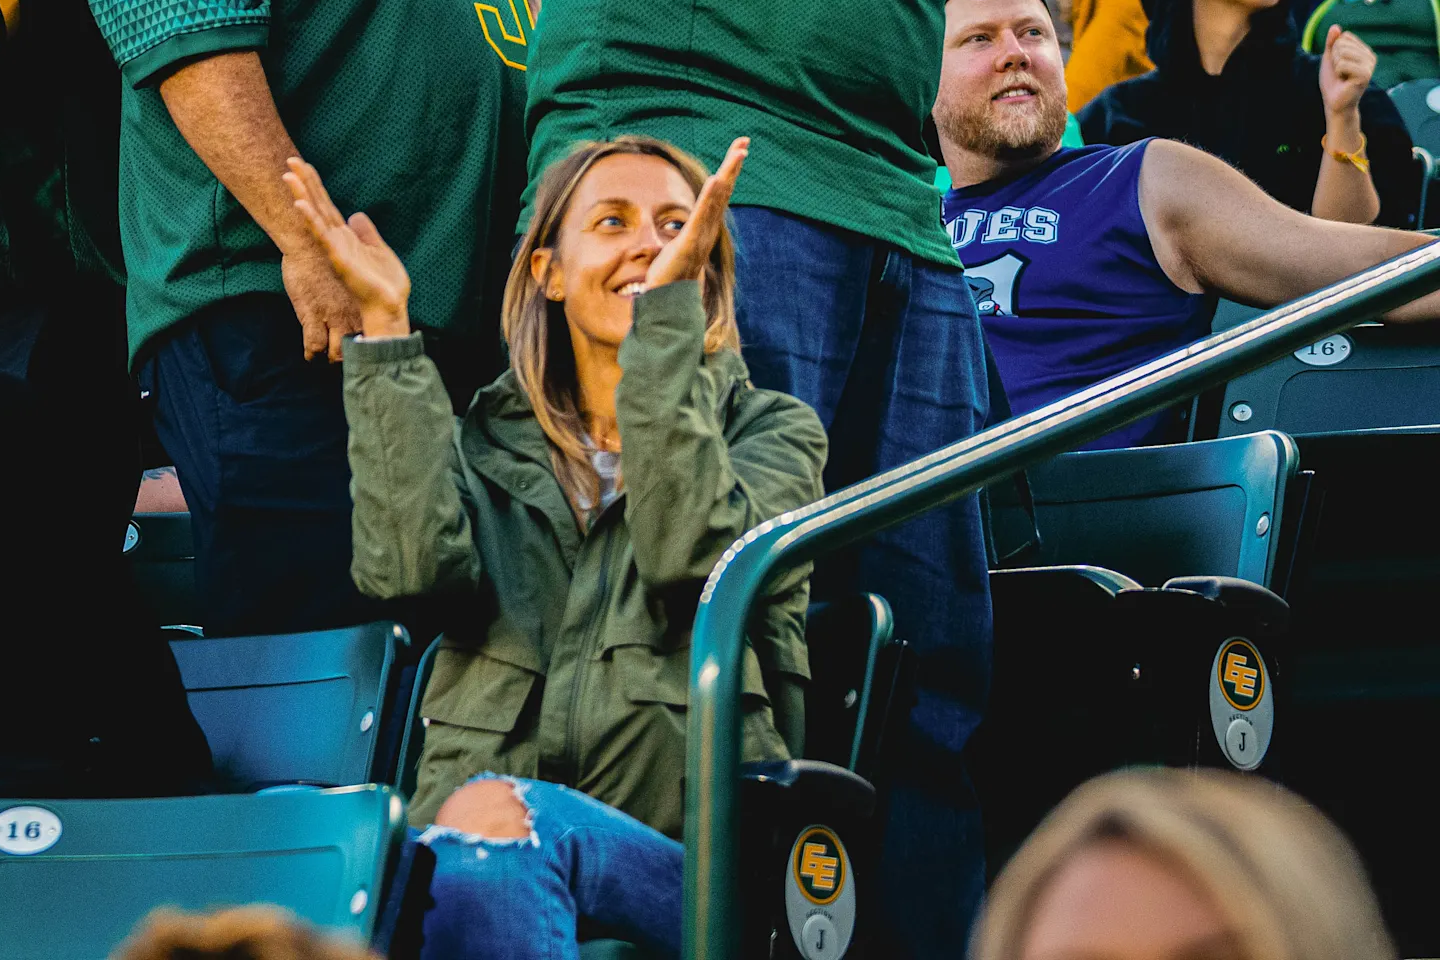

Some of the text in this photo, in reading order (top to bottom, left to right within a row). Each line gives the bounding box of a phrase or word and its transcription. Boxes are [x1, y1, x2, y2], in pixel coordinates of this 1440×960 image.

[1307, 341, 1335, 356] 16
[1238, 732, 1246, 751] J
[7, 821, 41, 839] 16
[815, 929, 825, 950] J
